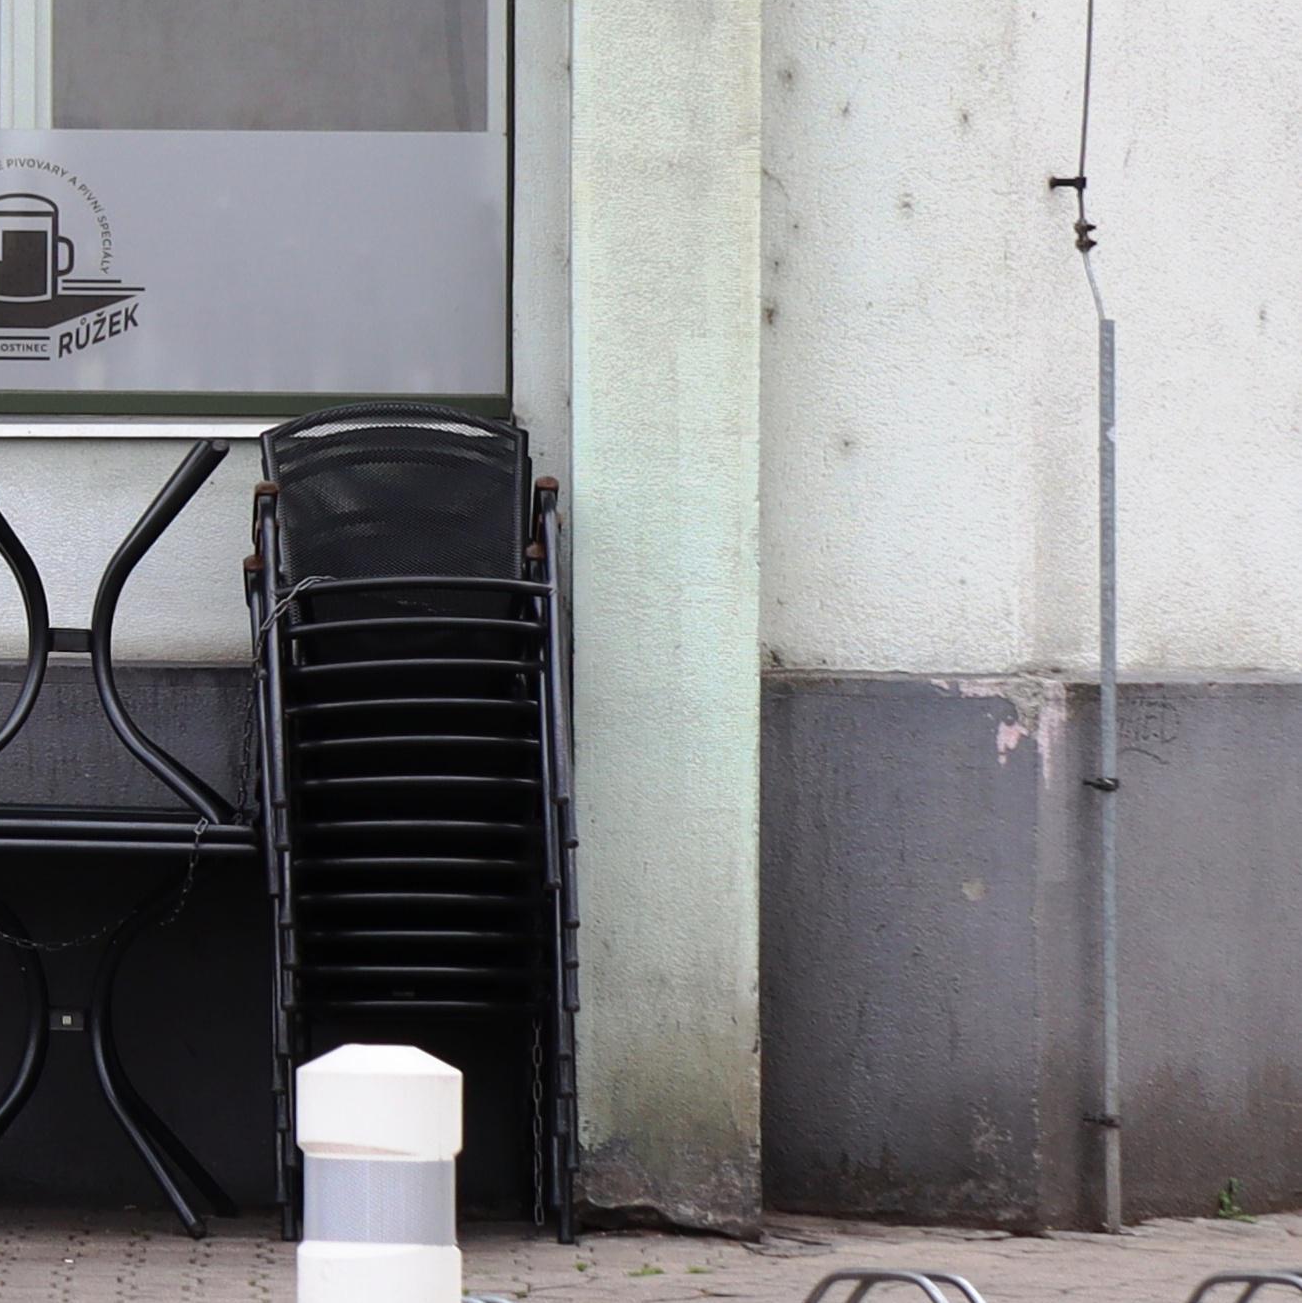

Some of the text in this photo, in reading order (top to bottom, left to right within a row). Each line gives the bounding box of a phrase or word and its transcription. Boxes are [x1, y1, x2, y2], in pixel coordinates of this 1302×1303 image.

[6, 157, 69, 179] PIVOVARY
[68, 175, 78, 186] A
[77, 183, 103, 214] PIVNÍ
[96, 214, 113, 275] SPECIÁLY
[58, 302, 140, 359] RŮŽEK
